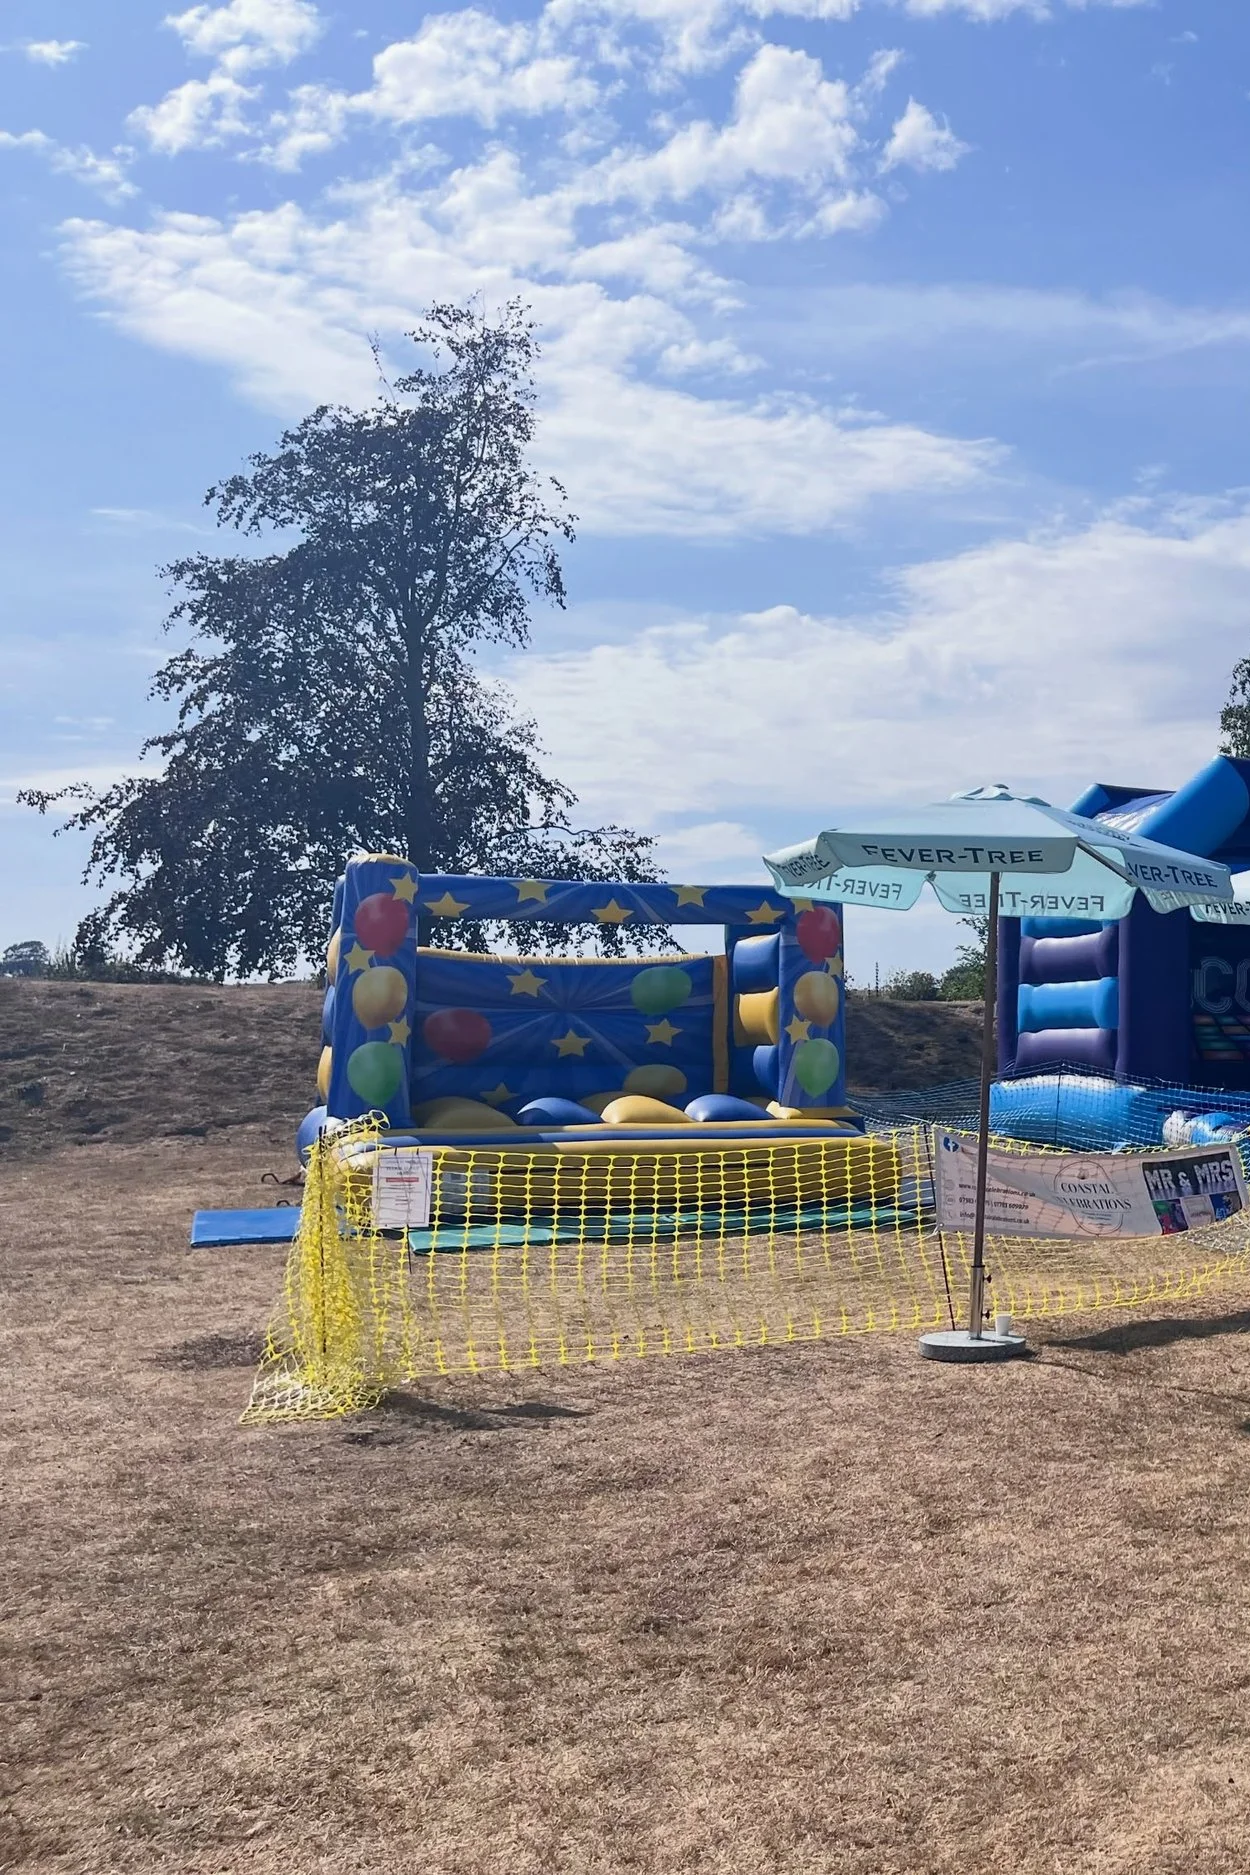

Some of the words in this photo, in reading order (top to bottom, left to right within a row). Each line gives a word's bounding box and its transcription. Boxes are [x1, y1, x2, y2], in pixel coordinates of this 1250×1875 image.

[862, 844, 1044, 864] FEVER-TREE
[1144, 1169, 1176, 1190] MR
[1178, 1172, 1191, 1188] &
[1194, 1160, 1234, 1183] MRS
[1061, 1182, 1115, 1195] COASTAL
